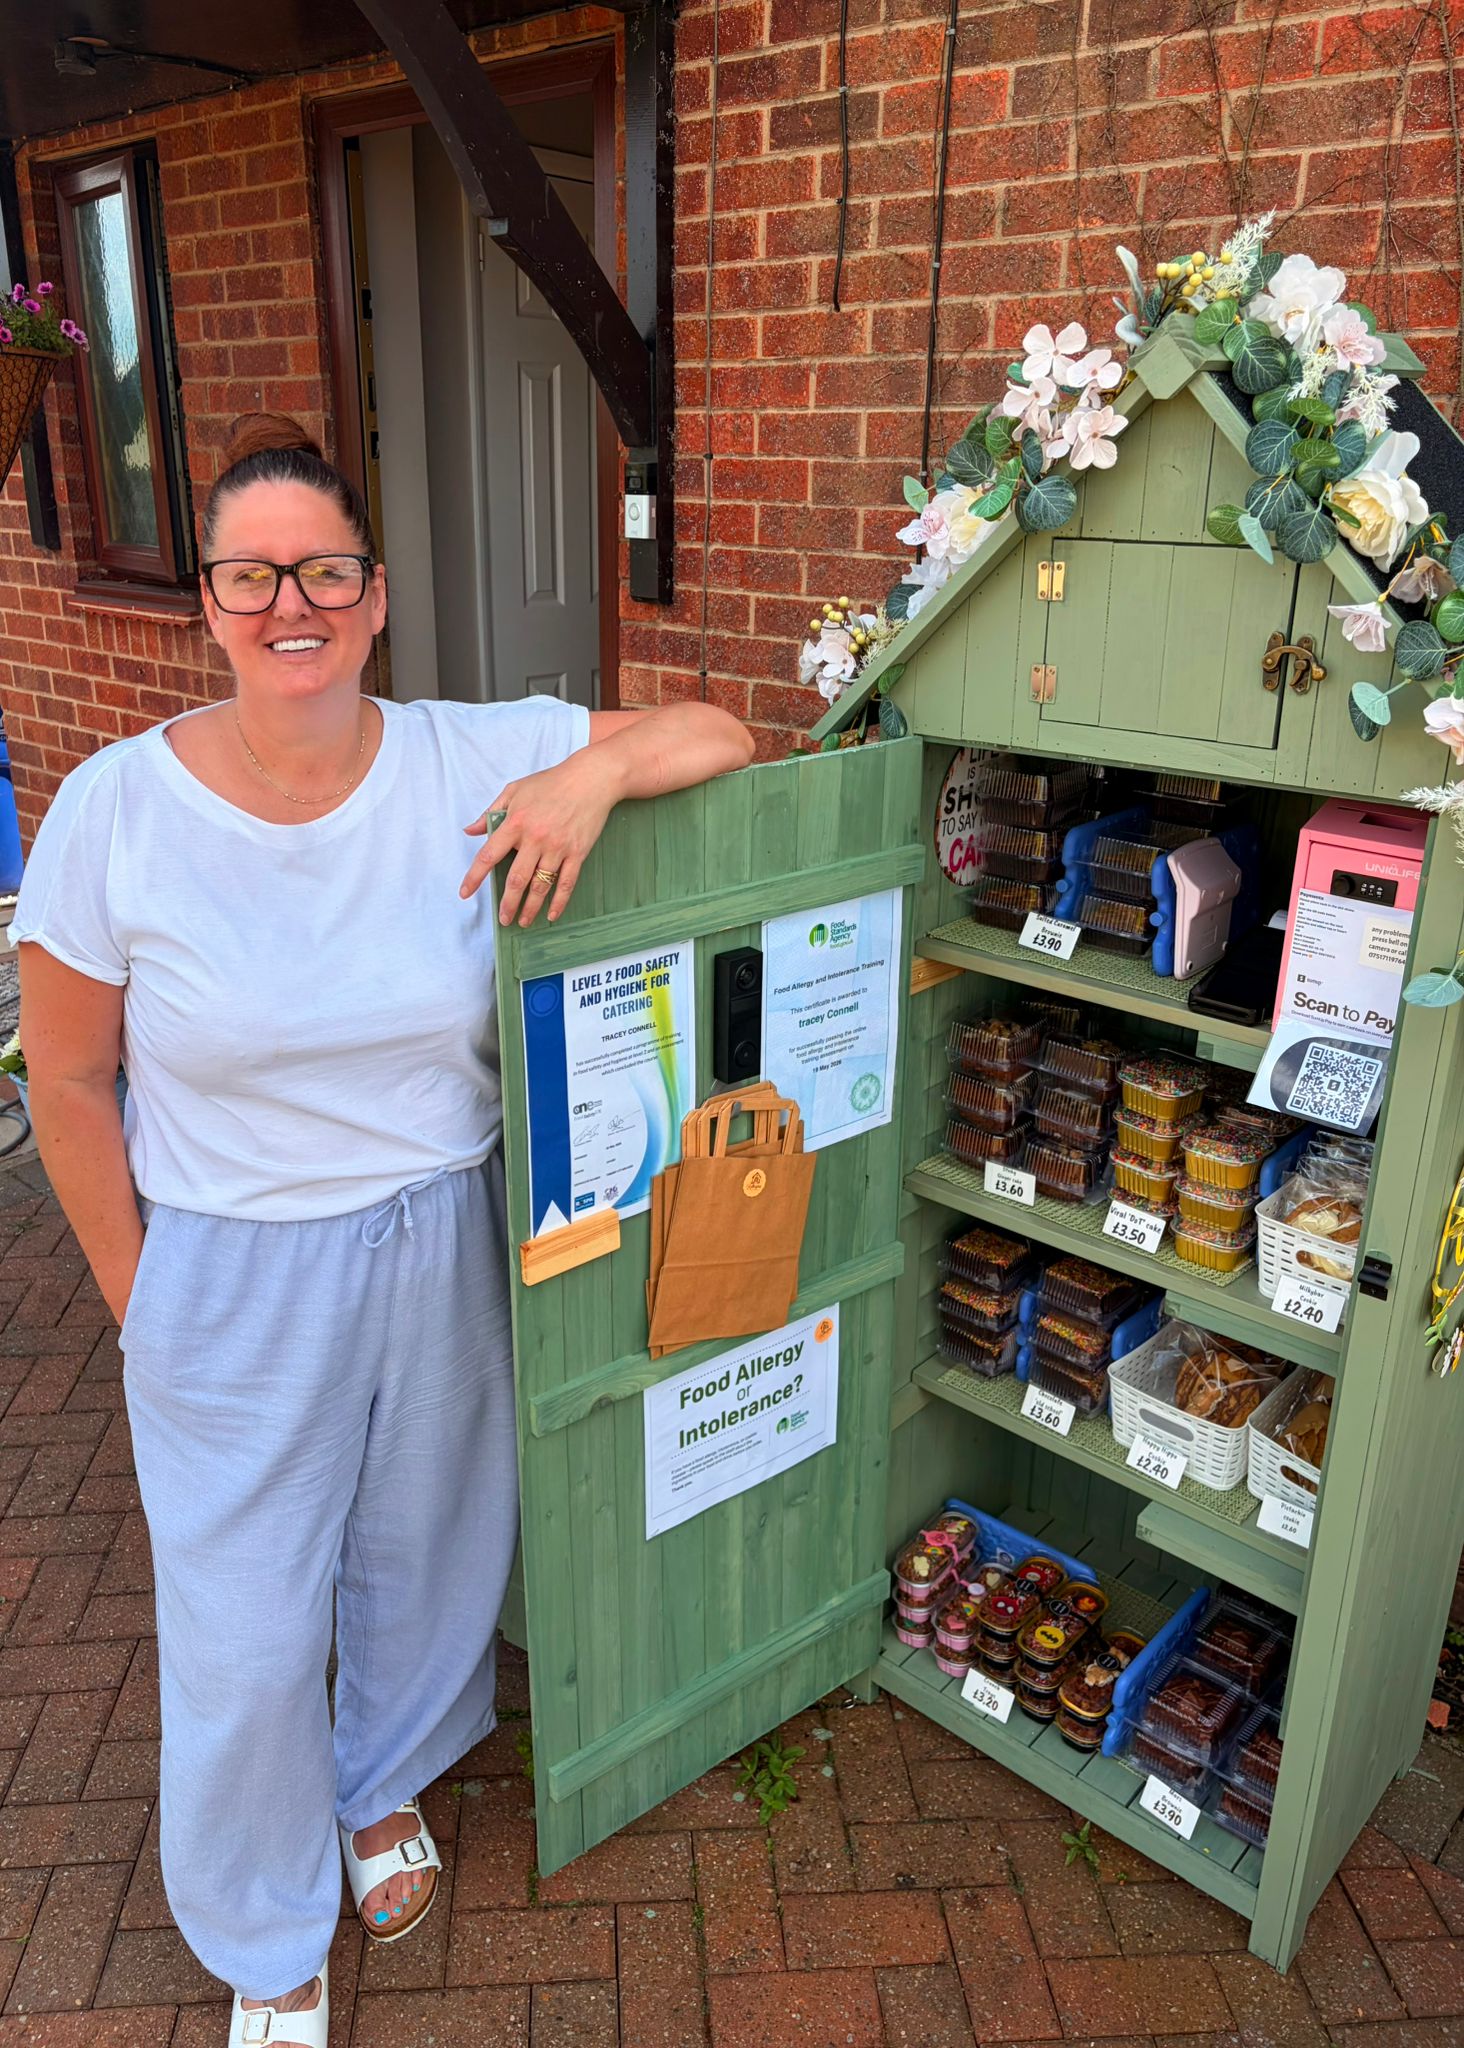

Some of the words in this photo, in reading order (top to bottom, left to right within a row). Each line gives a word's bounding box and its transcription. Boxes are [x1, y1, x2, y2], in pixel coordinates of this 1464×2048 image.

[968, 766, 975, 780] IS
[942, 817, 956, 837] TO
[958, 811, 978, 832] SAY
[830, 923, 857, 936] Standards
[831, 920, 846, 929] Food
[1372, 927, 1382, 935] any
[830, 932, 851, 943] Agency
[1032, 933, 1062, 952] £3.90
[1368, 944, 1390, 953] camera
[1372, 936, 1388, 945] press
[1388, 937, 1400, 946] bell
[572, 973, 602, 992] LEVEL
[605, 971, 612, 983] 2
[615, 963, 642, 981] FOOD
[645, 952, 680, 973] SAFETY
[774, 985, 791, 995] Food
[791, 979, 814, 991] Allergy
[815, 975, 827, 984] and
[827, 966, 860, 981] Intolerance
[861, 959, 885, 971] Training
[580, 991, 601, 1008] AND
[605, 978, 648, 1002] HYGIENE
[651, 973, 670, 989] FOR
[791, 1006, 803, 1015] This
[804, 998, 831, 1011] certificate
[837, 988, 861, 1001] awarded
[603, 995, 653, 1020] CATERING
[799, 1014, 825, 1028] tracey
[827, 1001, 859, 1019] Connell
[1294, 991, 1339, 1017] Scan
[1342, 1005, 1360, 1022] to
[1363, 1010, 1396, 1034] Pay
[602, 1030, 627, 1043] TRACEY
[628, 1021, 657, 1035] CONNELL
[819, 1062, 830, 1072] May
[995, 1180, 1024, 1197] £3.60
[1110, 1206, 1127, 1219] Viral
[1146, 1223, 1162, 1234] cake
[1112, 1222, 1146, 1245] £3.50
[1299, 1284, 1324, 1298] Milkybar
[1283, 1299, 1324, 1324] £2.40
[680, 1370, 731, 1410] Food
[735, 1340, 805, 1386] Allergy
[737, 1383, 753, 1402] or
[679, 1374, 803, 1449] Intolerance?
[1030, 1405, 1060, 1428] £3.60
[1136, 1455, 1169, 1480] £2.40
[972, 1688, 999, 1712] £3.20
[1153, 1799, 1182, 1826] £3.90
